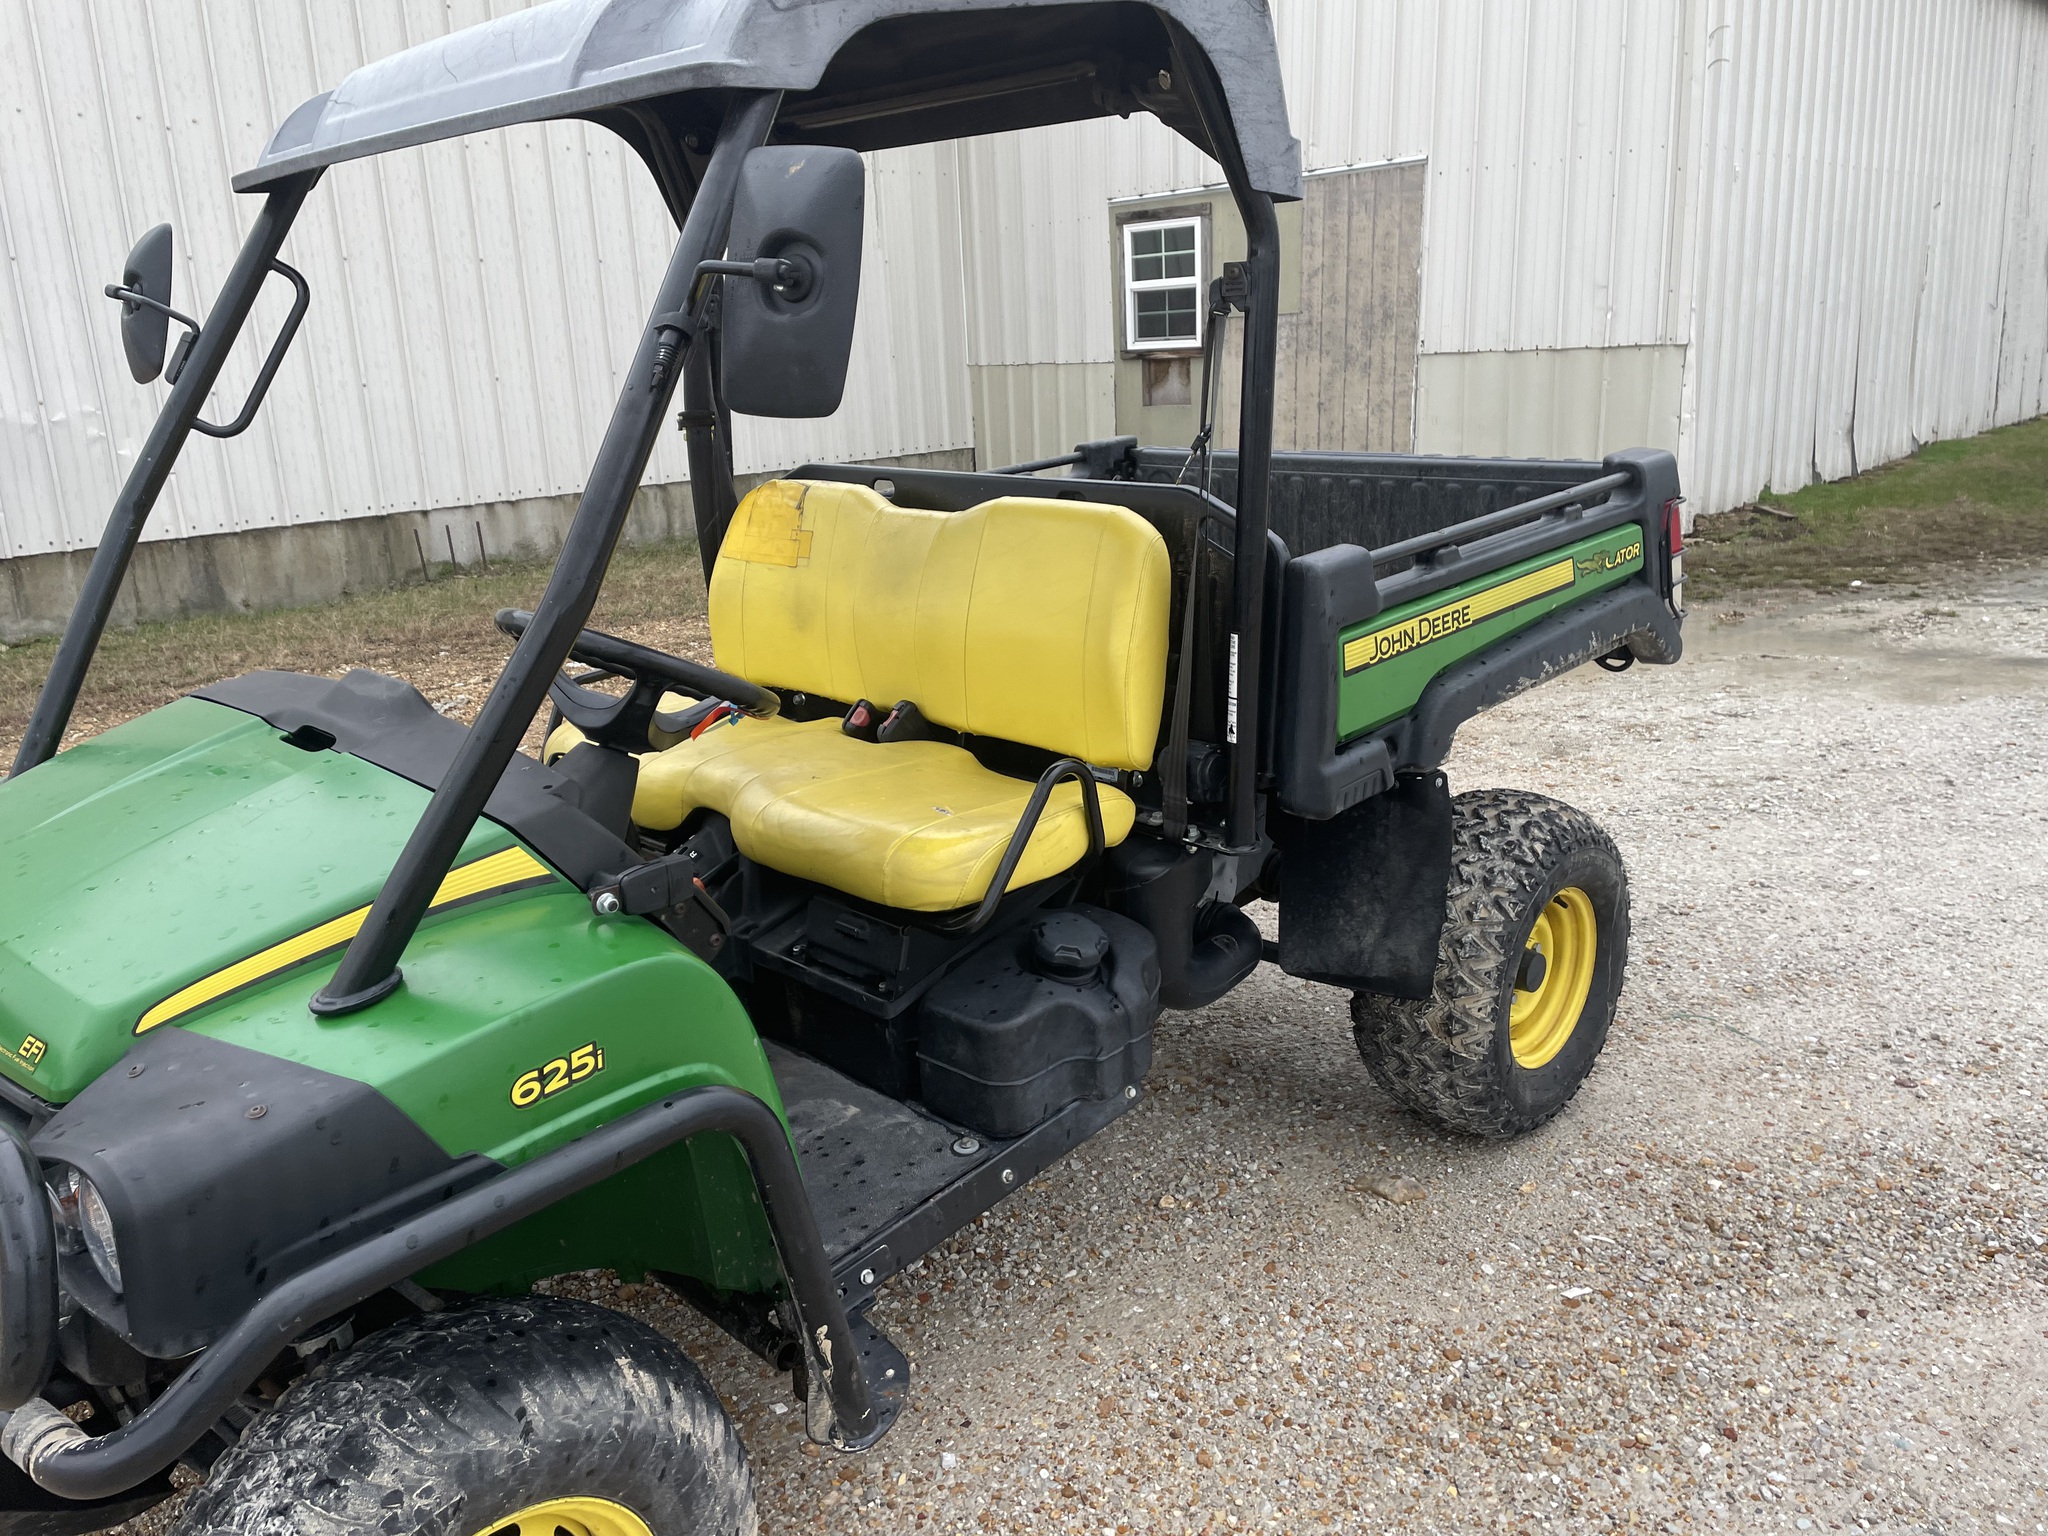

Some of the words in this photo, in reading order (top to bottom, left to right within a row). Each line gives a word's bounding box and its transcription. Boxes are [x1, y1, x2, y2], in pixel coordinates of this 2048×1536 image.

[1369, 625, 1416, 663] JOHN
[1418, 604, 1472, 642] DEERE
[18, 1034, 46, 1064] EFI
[510, 1042, 603, 1107] 625i
